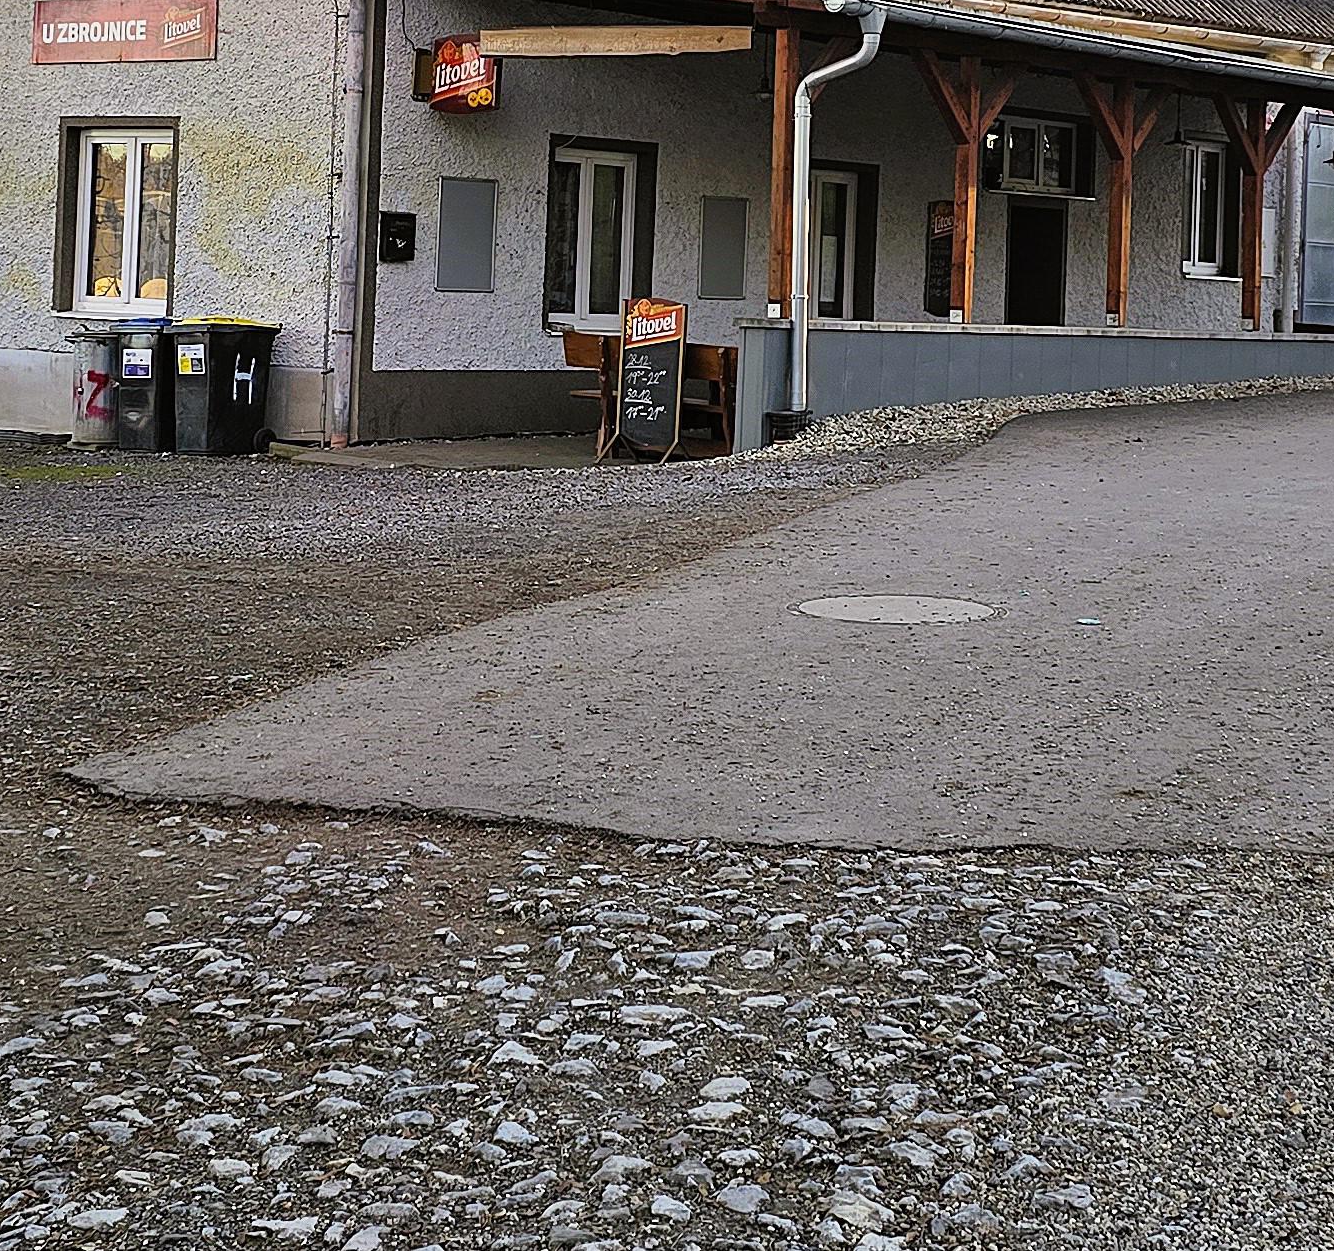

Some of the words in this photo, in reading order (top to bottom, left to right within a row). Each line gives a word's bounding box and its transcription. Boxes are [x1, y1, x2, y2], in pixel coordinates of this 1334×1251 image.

[42, 24, 54, 43] U
[57, 19, 147, 43] ZBROJNICE
[163, 13, 201, 44] Litovel
[435, 57, 486, 93] Litovel
[632, 311, 677, 341] Litovel
[233, 353, 255, 405] H
